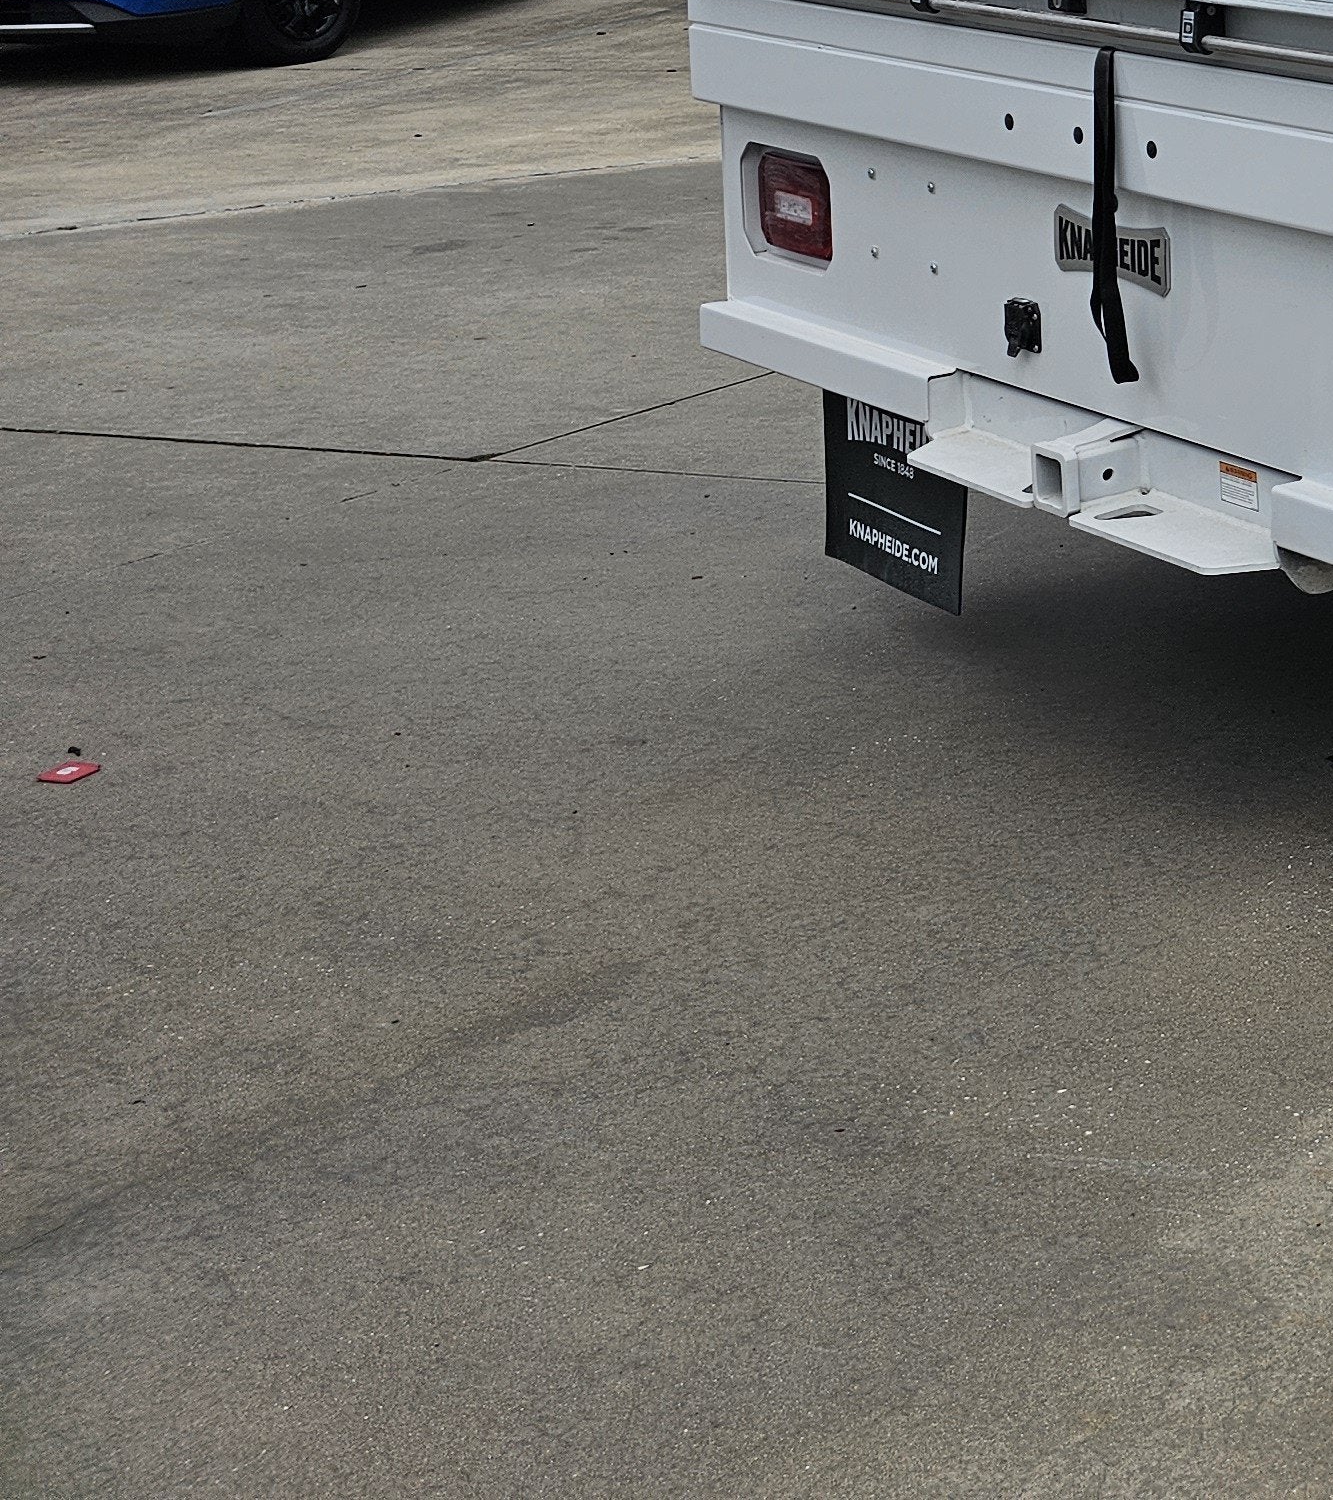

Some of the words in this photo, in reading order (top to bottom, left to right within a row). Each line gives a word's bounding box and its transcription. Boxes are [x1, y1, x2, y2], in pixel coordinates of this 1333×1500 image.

[1058, 215, 1162, 286] KNAEIDE
[846, 397, 928, 455] KNAPHEI
[873, 452, 896, 472] SINCE
[897, 462, 914, 479] 1848
[849, 518, 939, 575] KNAPHEIDE.COM
